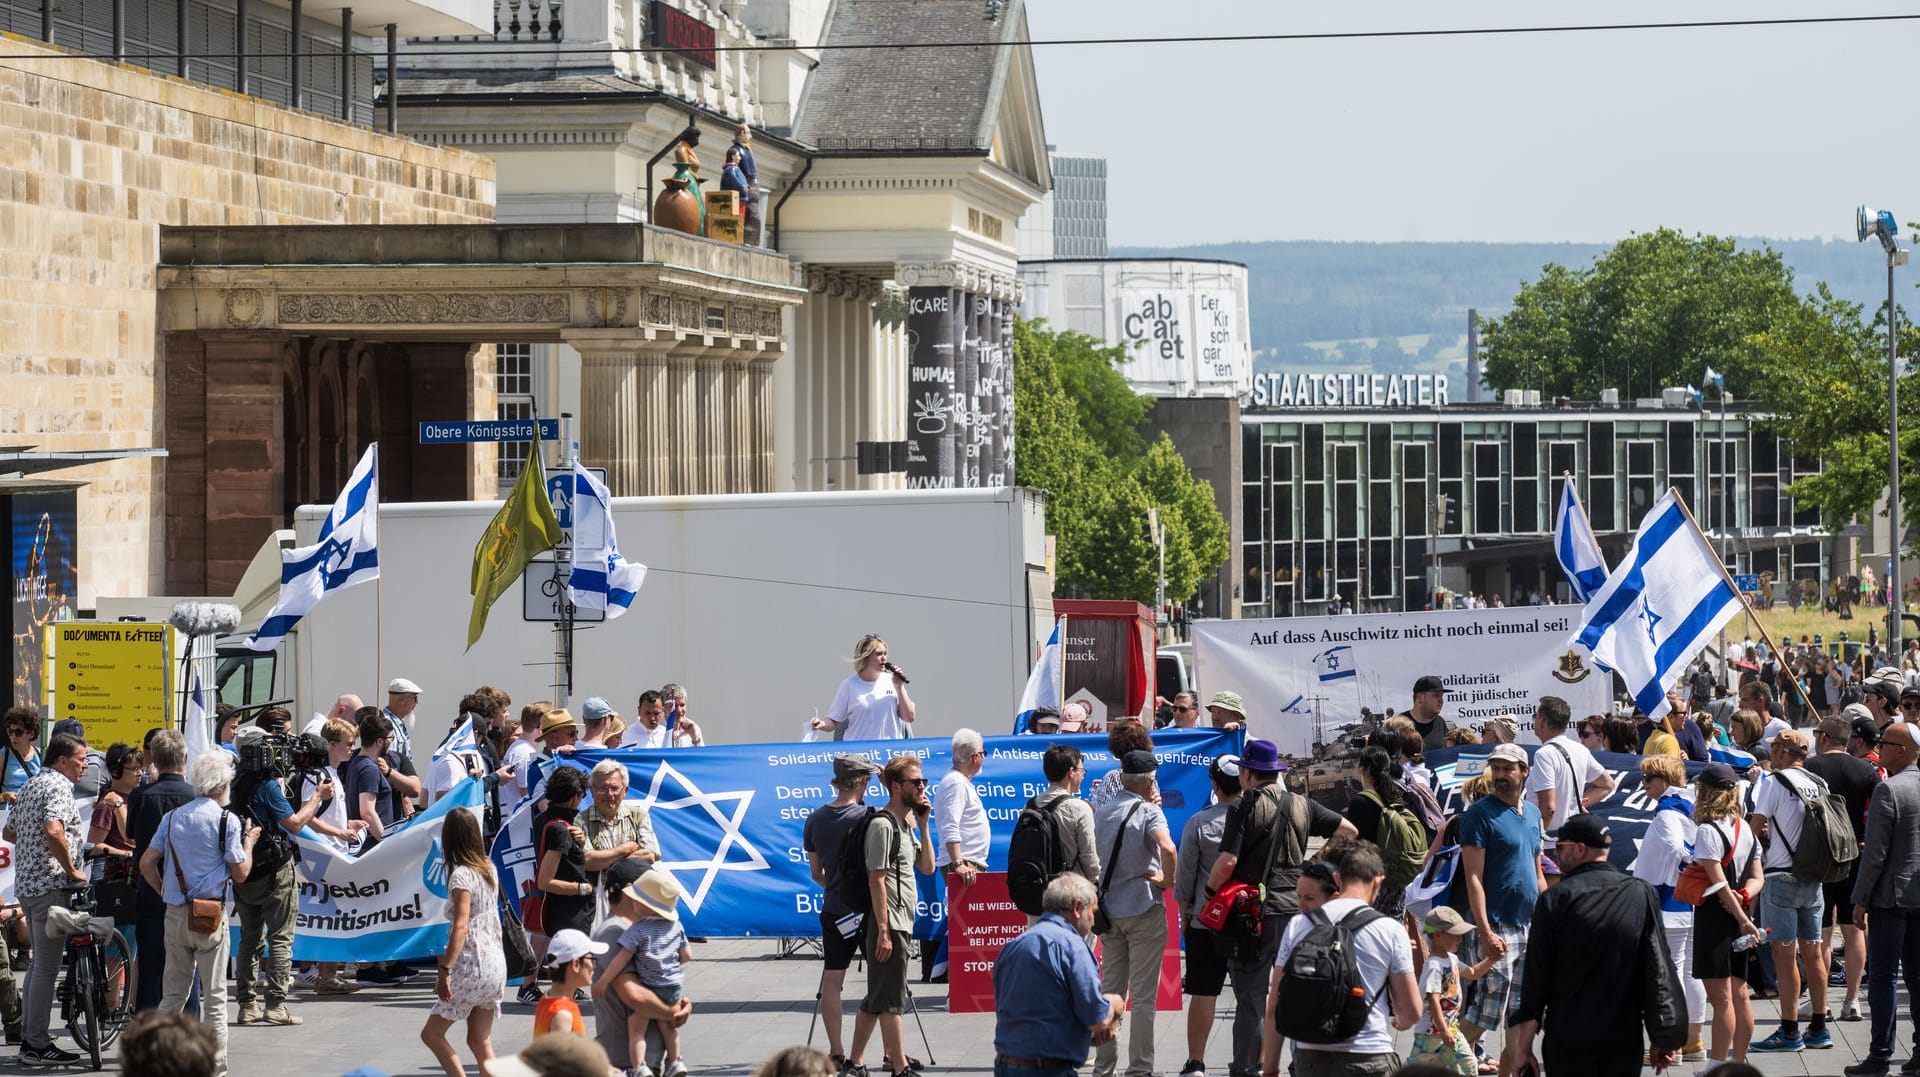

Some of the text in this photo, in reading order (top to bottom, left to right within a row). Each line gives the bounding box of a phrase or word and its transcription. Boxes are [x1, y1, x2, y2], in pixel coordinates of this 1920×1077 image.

[1214, 311, 1229, 327] Kir
[1210, 328, 1230, 343] sch
[1203, 347, 1222, 364] gar
[1213, 363, 1233, 377] ten
[1253, 374, 1449, 406] STAATSTHEATER
[426, 424, 549, 440] Obere Königsstrae
[1250, 617, 1569, 646] Auf dass Auschwitz nicht noch einmal sei!
[1447, 688, 1529, 703] mit jüdischer
[1458, 704, 1537, 718] Souveränität
[767, 751, 846, 766] Solidarit
[776, 786, 823, 800] Dem
[976, 782, 1016, 797] eine
[318, 878, 389, 904] jeden
[296, 893, 423, 931] emitismus!
[968, 902, 1019, 911] NIE WIEDE
[963, 925, 999, 936] „KAUFT
[969, 937, 1013, 947] BEI JUDE
[963, 961, 995, 972] STOP
